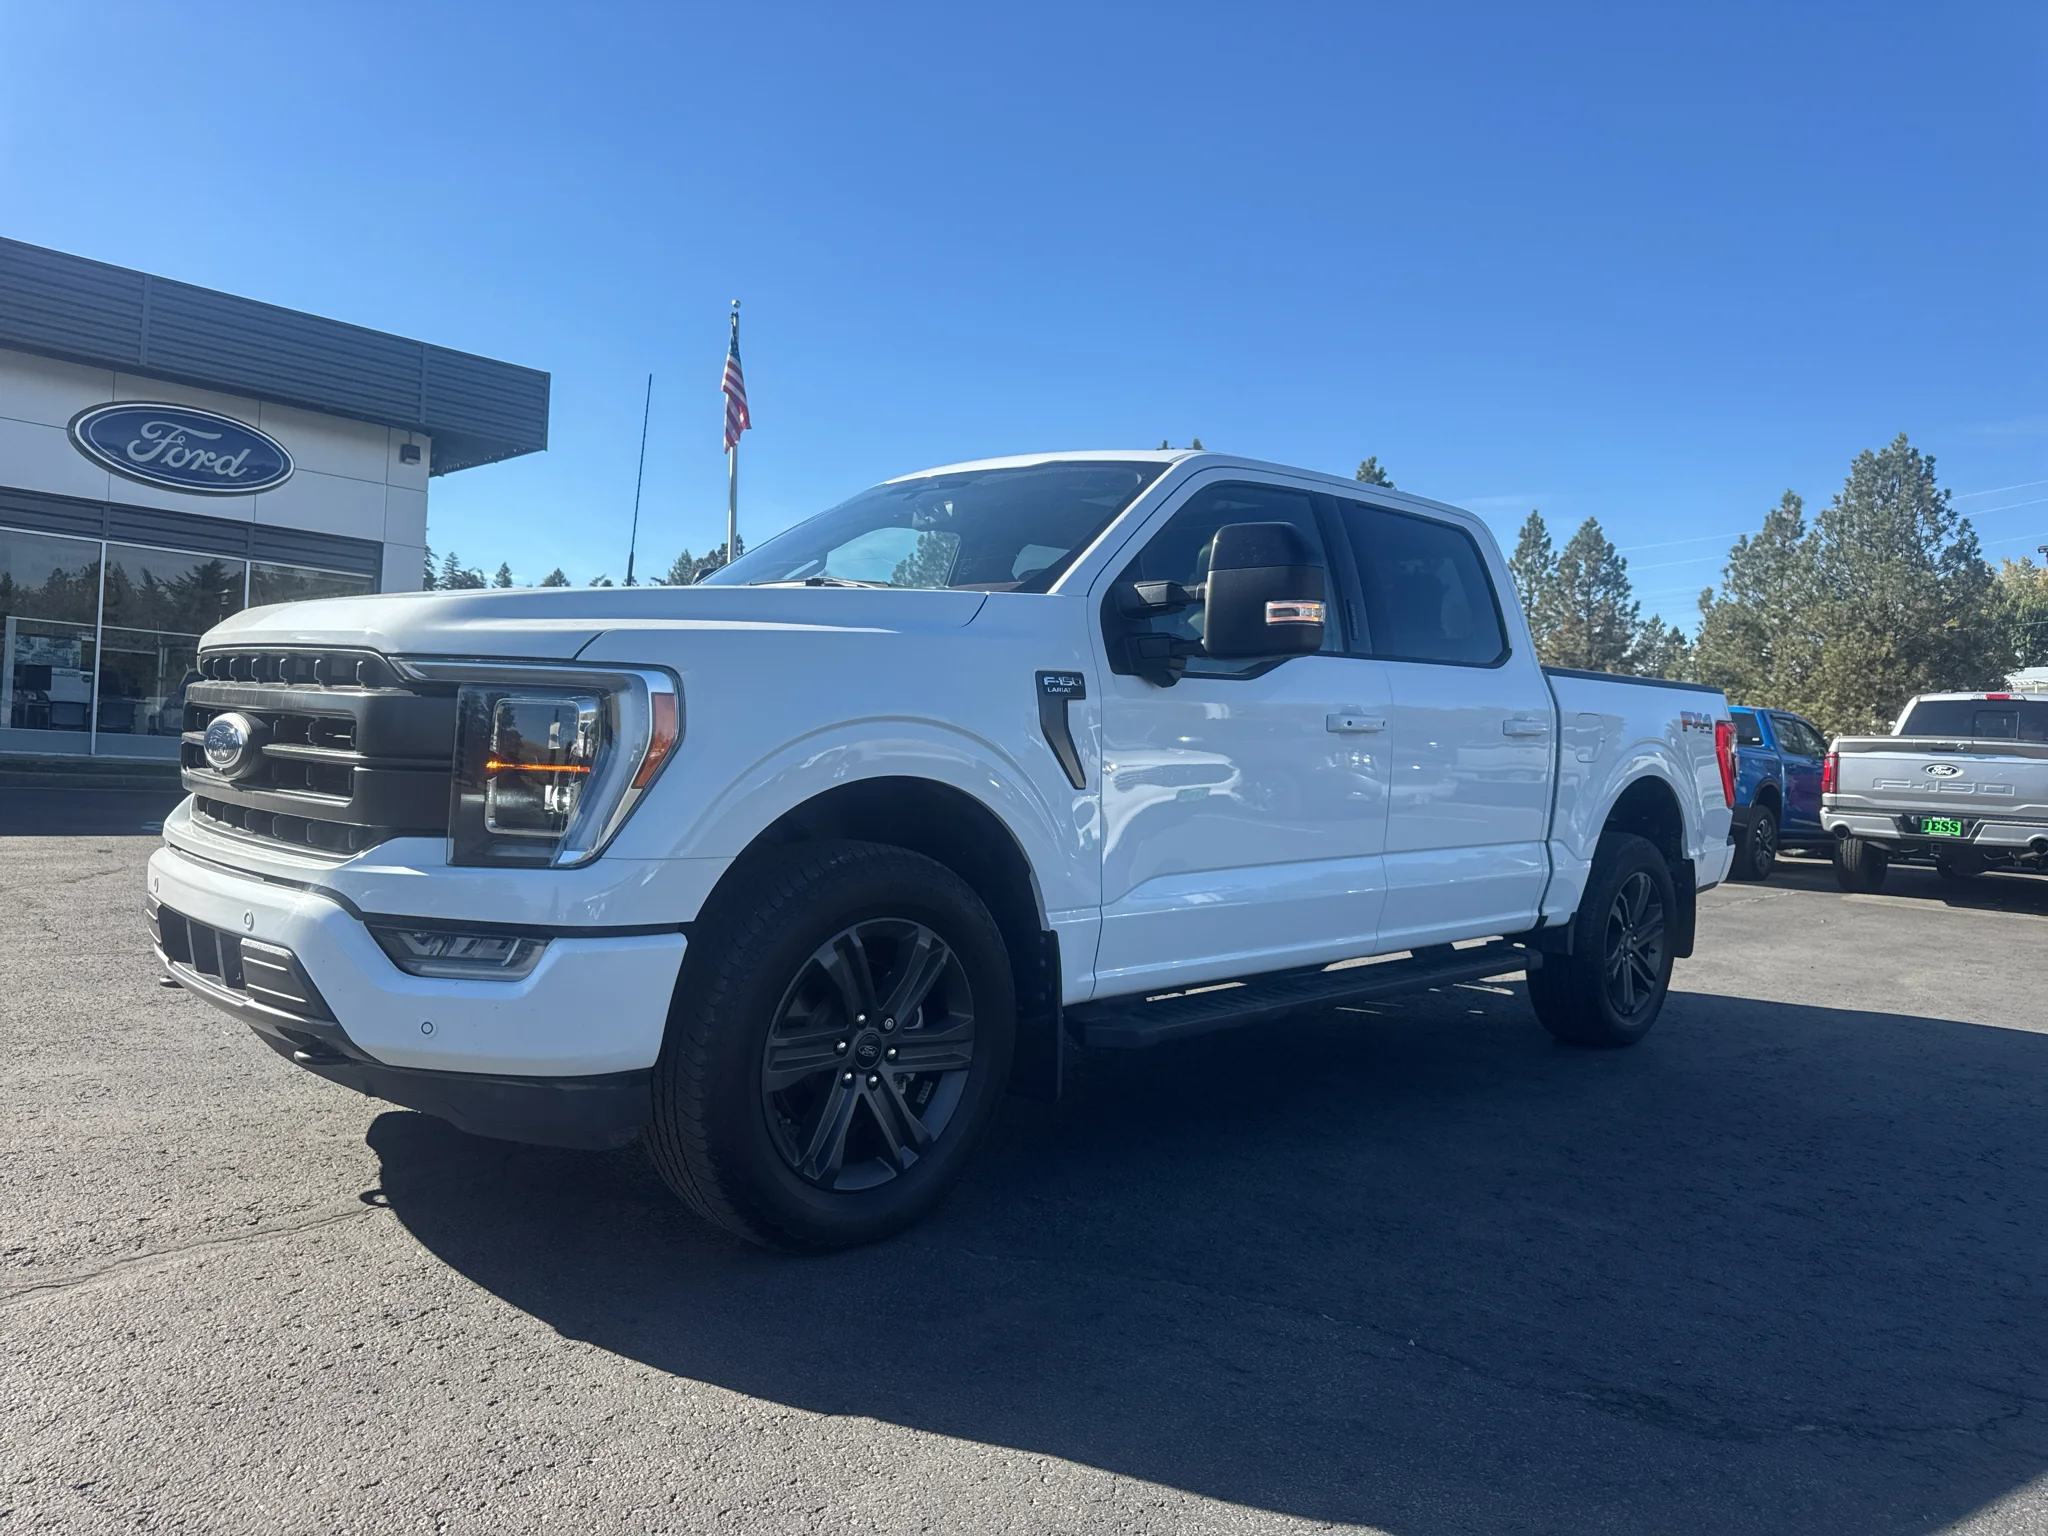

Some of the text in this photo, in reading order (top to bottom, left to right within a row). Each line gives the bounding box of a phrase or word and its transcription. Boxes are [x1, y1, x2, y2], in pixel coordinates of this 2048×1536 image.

[126, 420, 252, 478] Ford
[1043, 676, 1083, 686] F-150
[1931, 764, 1954, 776] Ford
[1872, 778, 2016, 797] F-150
[1923, 820, 1960, 833] JESS
[861, 1045, 877, 1056] Ford
